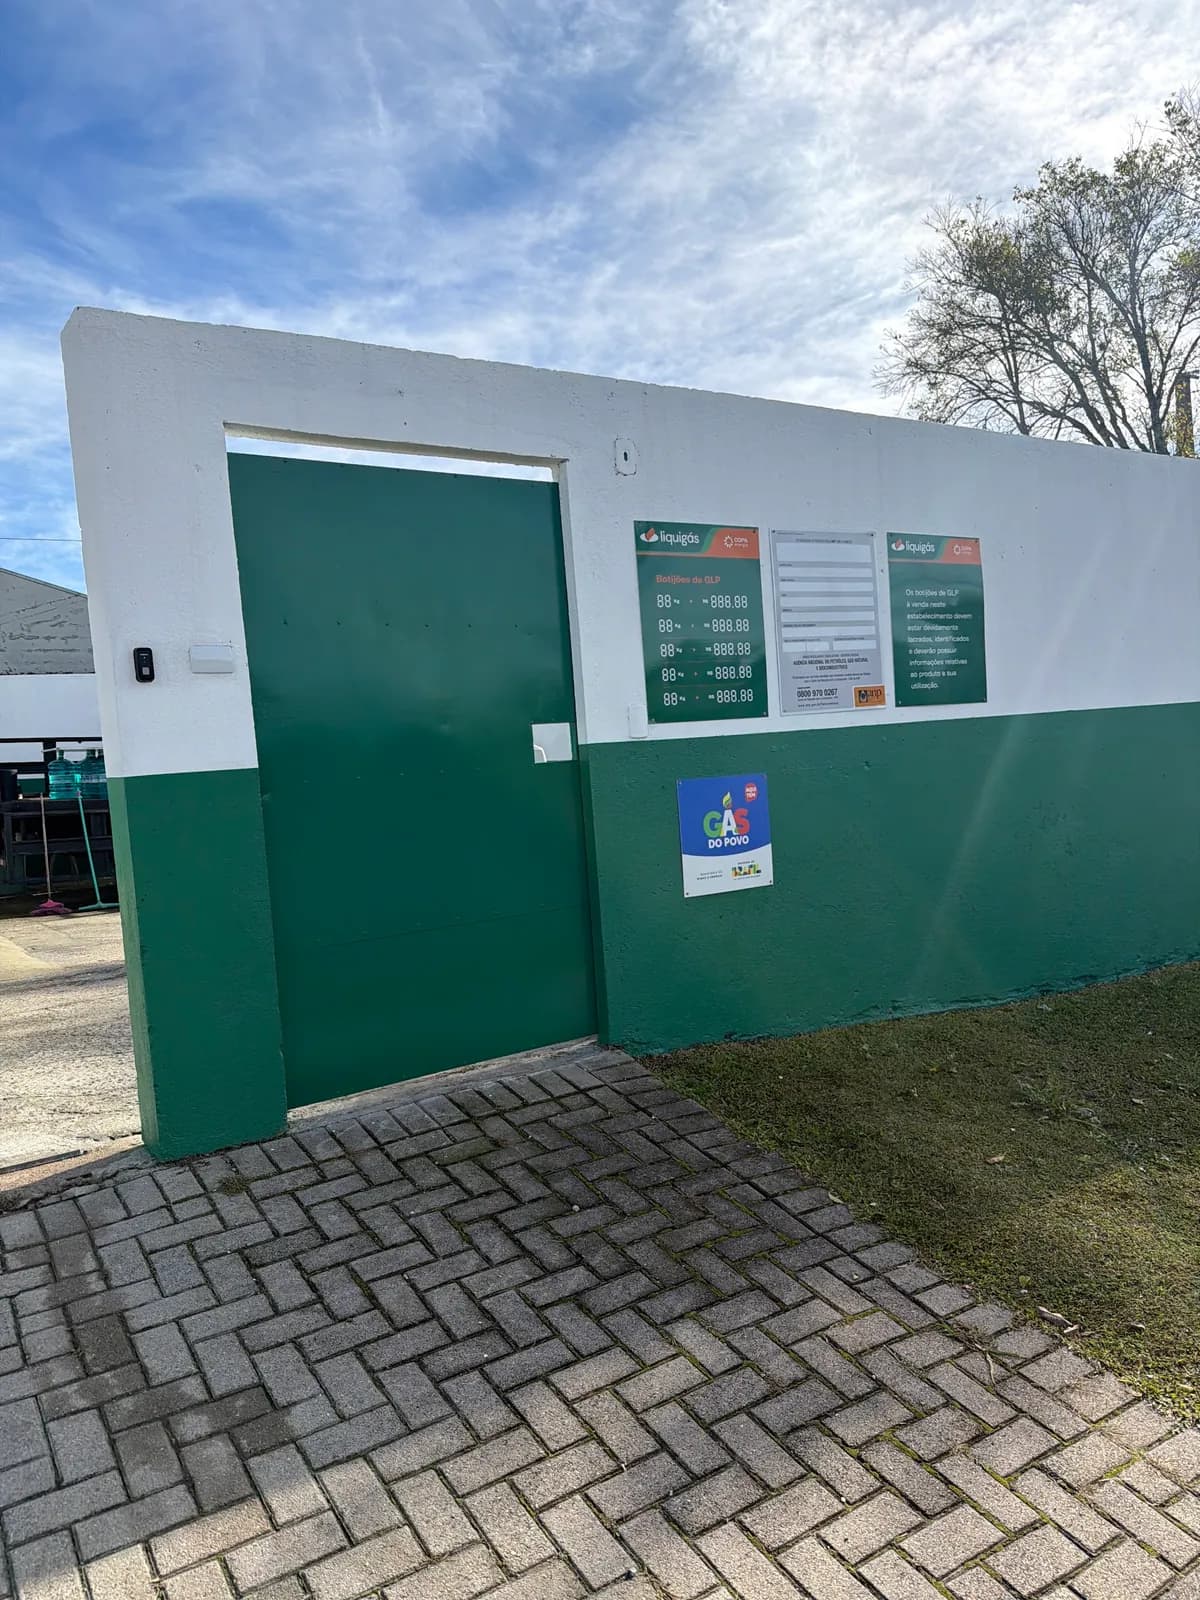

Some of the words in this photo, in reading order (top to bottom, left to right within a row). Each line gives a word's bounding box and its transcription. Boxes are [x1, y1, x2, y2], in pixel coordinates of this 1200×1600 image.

[660, 530, 700, 546] liquigás
[906, 541, 935, 554] liquigás
[656, 575, 690, 584] Botijões
[704, 576, 721, 584] GLP
[915, 589, 937, 597] botijões
[657, 594, 671, 608] 88
[711, 595, 748, 608] 888.88
[659, 619, 673, 632] 88
[712, 619, 749, 632] 888.88
[660, 643, 674, 657] 88
[714, 642, 751, 656] 888.88
[662, 668, 676, 681] 88
[715, 665, 752, 679] 888.88
[664, 692, 678, 706] 88
[716, 689, 753, 703] 888.88
[824, 688, 838, 696] 0267
[708, 839, 722, 848] DO
[724, 835, 749, 847] POVO
